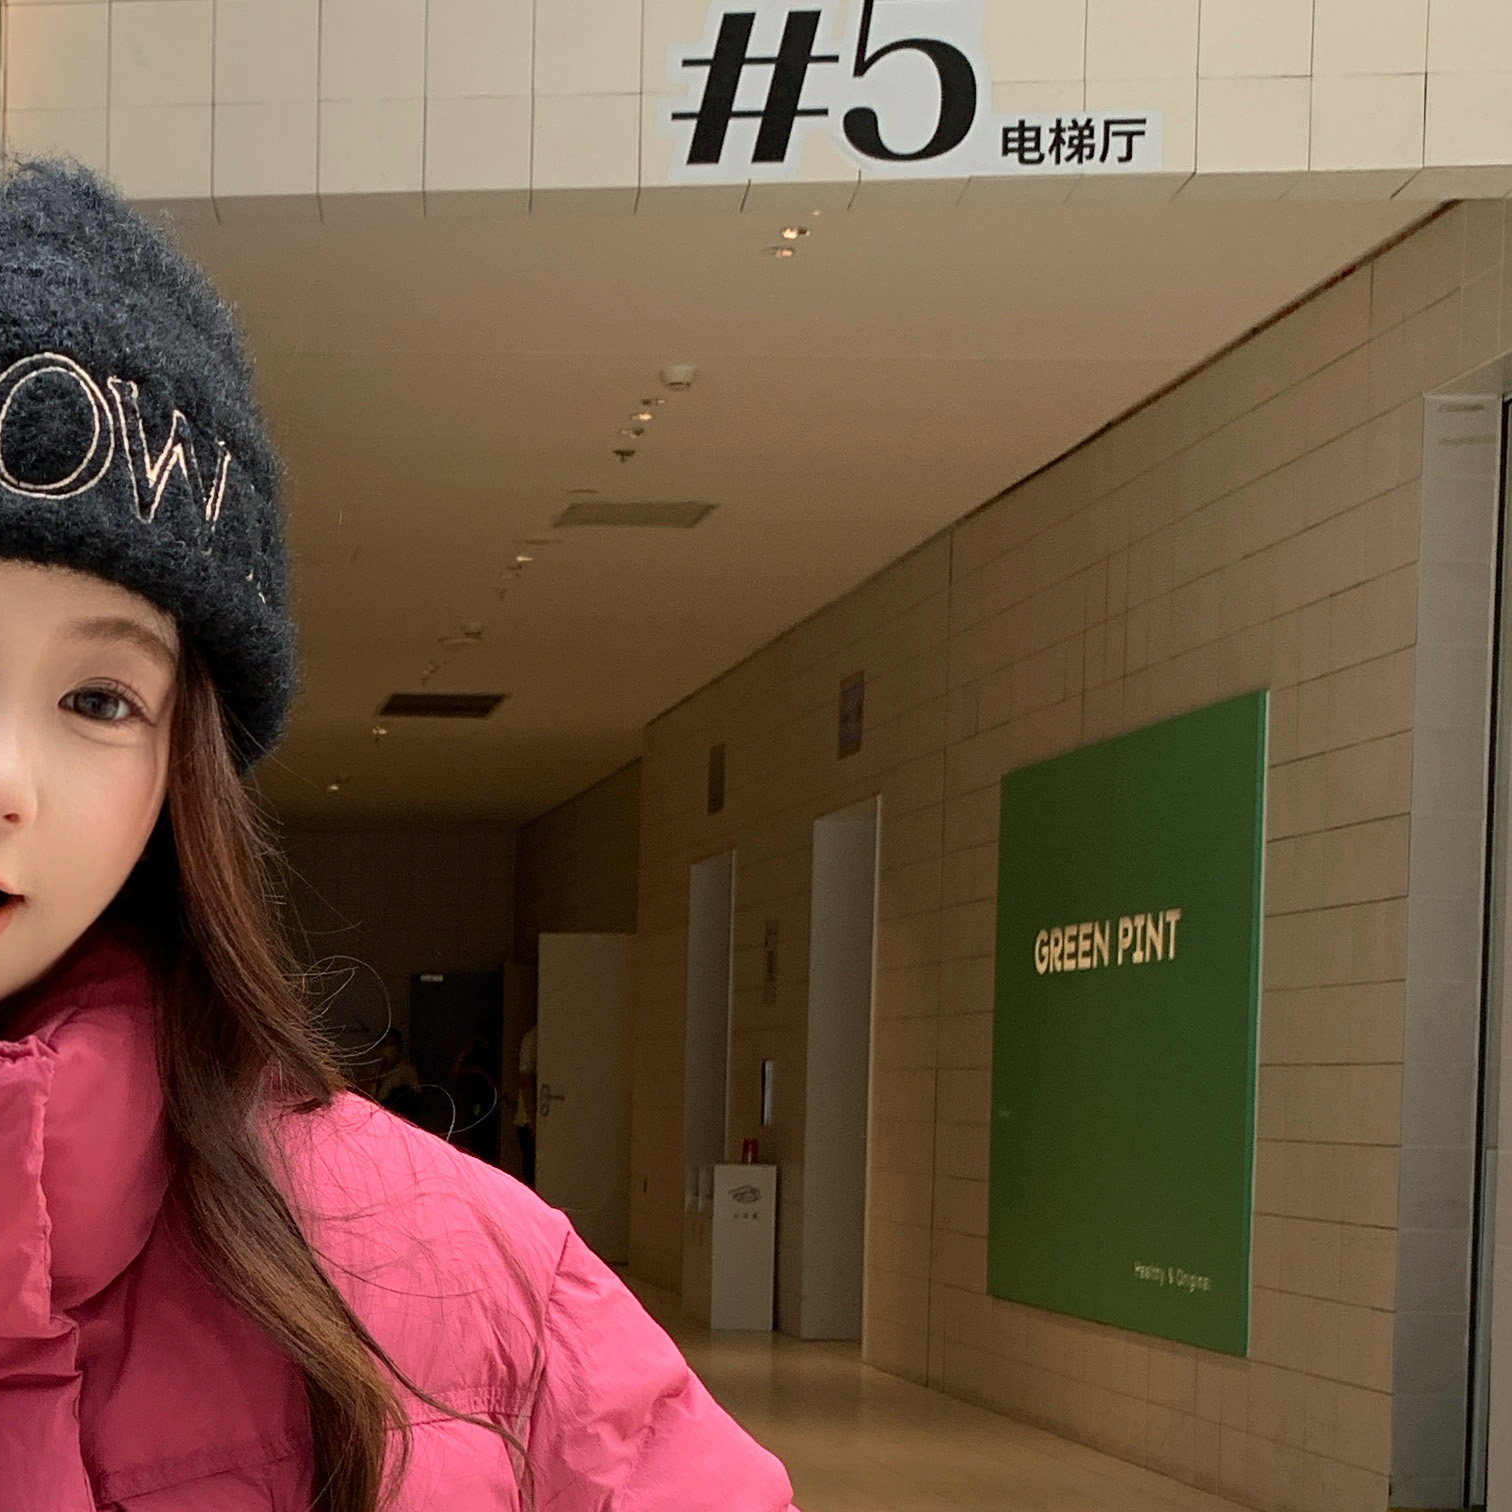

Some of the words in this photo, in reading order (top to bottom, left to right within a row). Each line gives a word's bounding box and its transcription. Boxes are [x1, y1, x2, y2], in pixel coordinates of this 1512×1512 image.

[671, 0, 977, 164] #5
[1001, 117, 1148, 166] 电梯厅
[1034, 918, 1111, 975] GREEN
[1117, 907, 1182, 966] PINT
